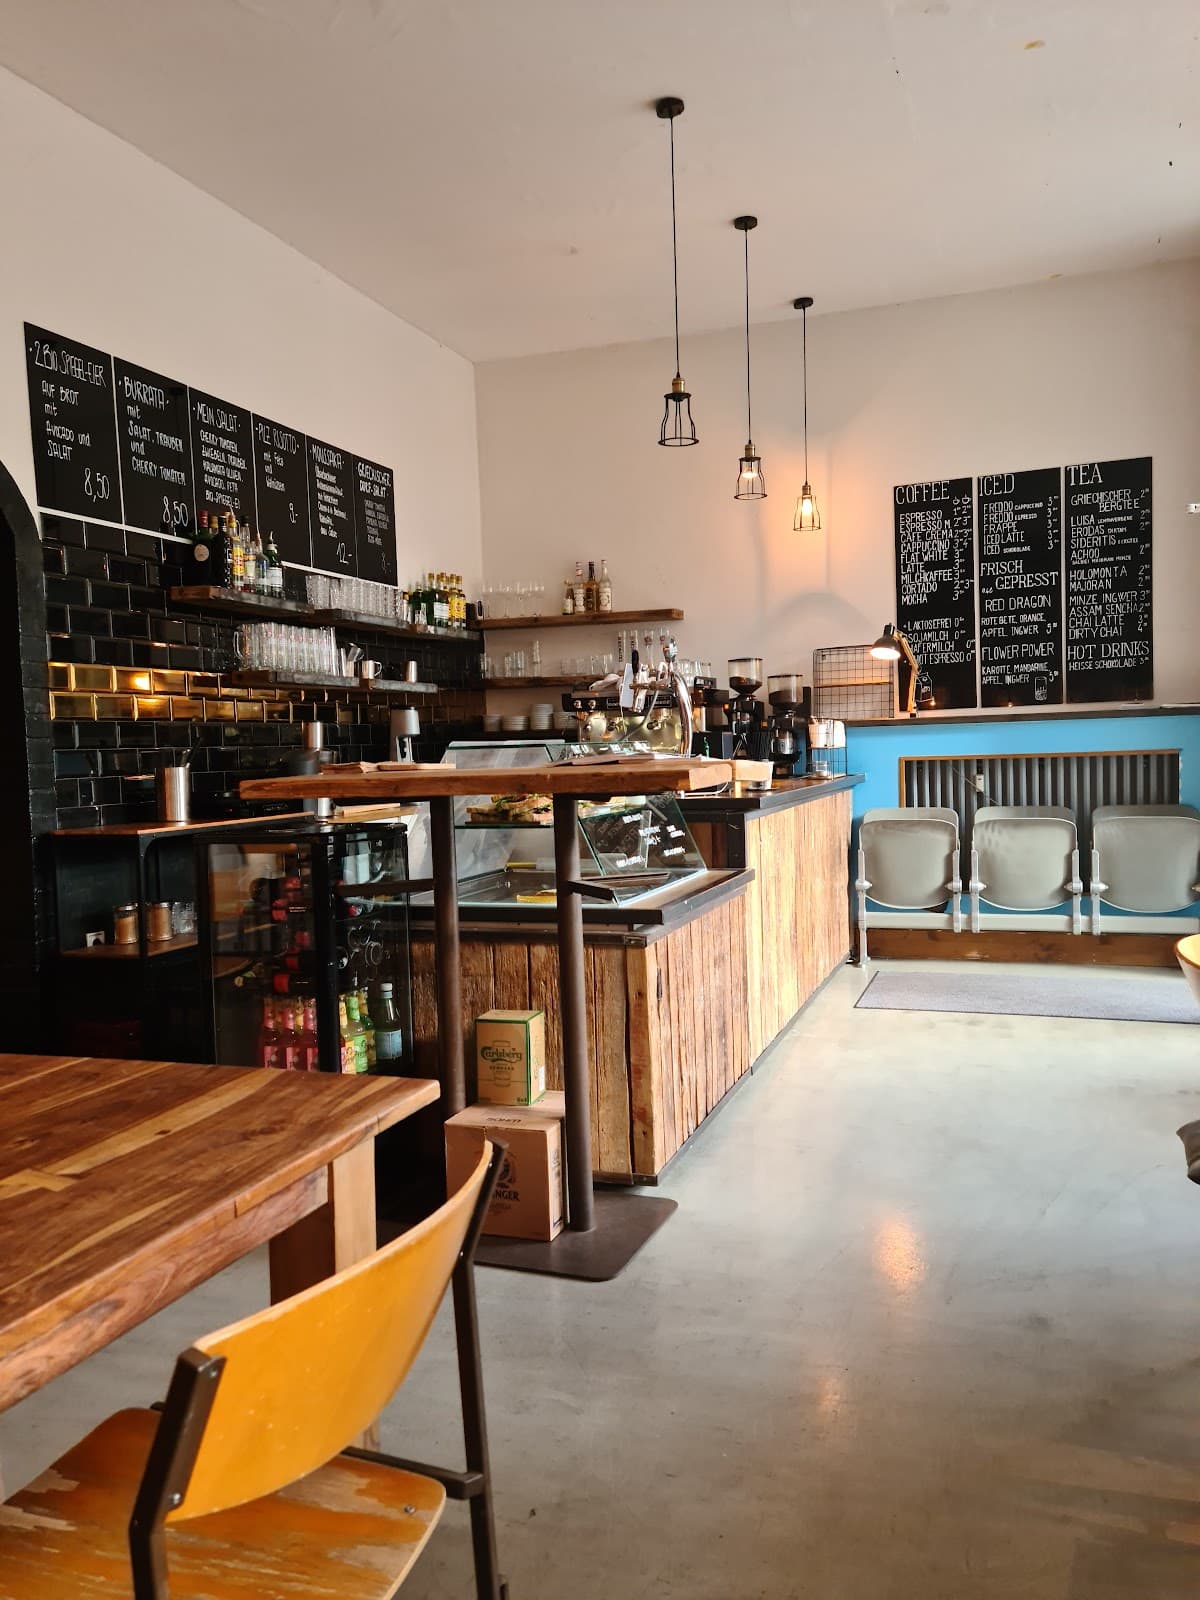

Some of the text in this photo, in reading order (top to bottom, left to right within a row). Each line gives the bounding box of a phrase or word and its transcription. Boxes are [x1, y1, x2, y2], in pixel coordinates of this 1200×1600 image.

[42, 380, 79, 406] AUF BROT
[124, 376, 165, 411] BURRATA
[45, 402, 57, 416] mit
[127, 405, 141, 420] mit
[197, 402, 238, 432] MEIN SALAT
[46, 420, 91, 447] AVOCADO und
[259, 423, 296, 455] PILZ RISOTTO
[47, 440, 73, 461] SALAT
[131, 441, 145, 456] und
[132, 456, 187, 486] CHERRY TOMATEN
[1066, 463, 1103, 487] TEA
[84, 467, 110, 503] 8,50
[895, 480, 950, 504] COFFEE
[978, 473, 1015, 497] ICED
[1070, 488, 1132, 506] GRIECHISCHER
[162, 496, 189, 528] 8,50
[983, 500, 1014, 514] FREDDO
[1098, 498, 1140, 513] BERGTEE
[899, 510, 943, 524] ESPRESSO
[983, 511, 1014, 524] FREDDO
[1070, 514, 1095, 527] LUISA
[899, 520, 943, 533] ESPRESSO
[983, 521, 1018, 535] FRAPPE
[1071, 524, 1105, 539] ERODAS
[925, 529, 954, 540] CREMA
[983, 534, 1000, 545] ICED
[1001, 531, 1025, 544] LATTE
[1070, 534, 1117, 549] SIDERITIS
[900, 539, 950, 553] CAPPUCCINO
[983, 544, 1001, 556] ICED
[900, 552, 920, 564] FLAT
[922, 550, 949, 561] WHITE
[901, 562, 925, 574] LATTE
[980, 559, 1024, 577] FRISCH
[901, 569, 953, 584] MILCHKAFFEE
[995, 571, 1059, 590] GEPRESST
[901, 582, 938, 595] CORTADO
[1069, 578, 1112, 592] MAJORAN
[901, 594, 928, 605] MOCHA
[985, 594, 1052, 613] RED DRAGON
[1069, 594, 1098, 606] MINZE
[1102, 591, 1138, 603] INGWER
[1069, 602, 1138, 617] ASSAM SENCHA
[907, 618, 952, 631] LAKTOSEFREI
[981, 616, 998, 626] ROTE
[1068, 616, 1092, 629] CHAI
[1095, 614, 1125, 627] LATTE
[907, 630, 949, 643] SOJAMILCH
[1011, 625, 1039, 637] INGWER
[1068, 627, 1099, 640] DIRTY
[1099, 626, 1123, 638] CHAI
[981, 644, 1019, 661] FLOWER
[1021, 642, 1055, 658] POWER
[1067, 640, 1150, 660] HOT DRINKS
[929, 652, 965, 664] ESPRESSO
[1068, 660, 1093, 671] HEISSE
[1094, 657, 1137, 670] SCHOKOLADE
[1005, 673, 1030, 685] INGWER
[480, 1046, 522, 1063] Carlsberg
